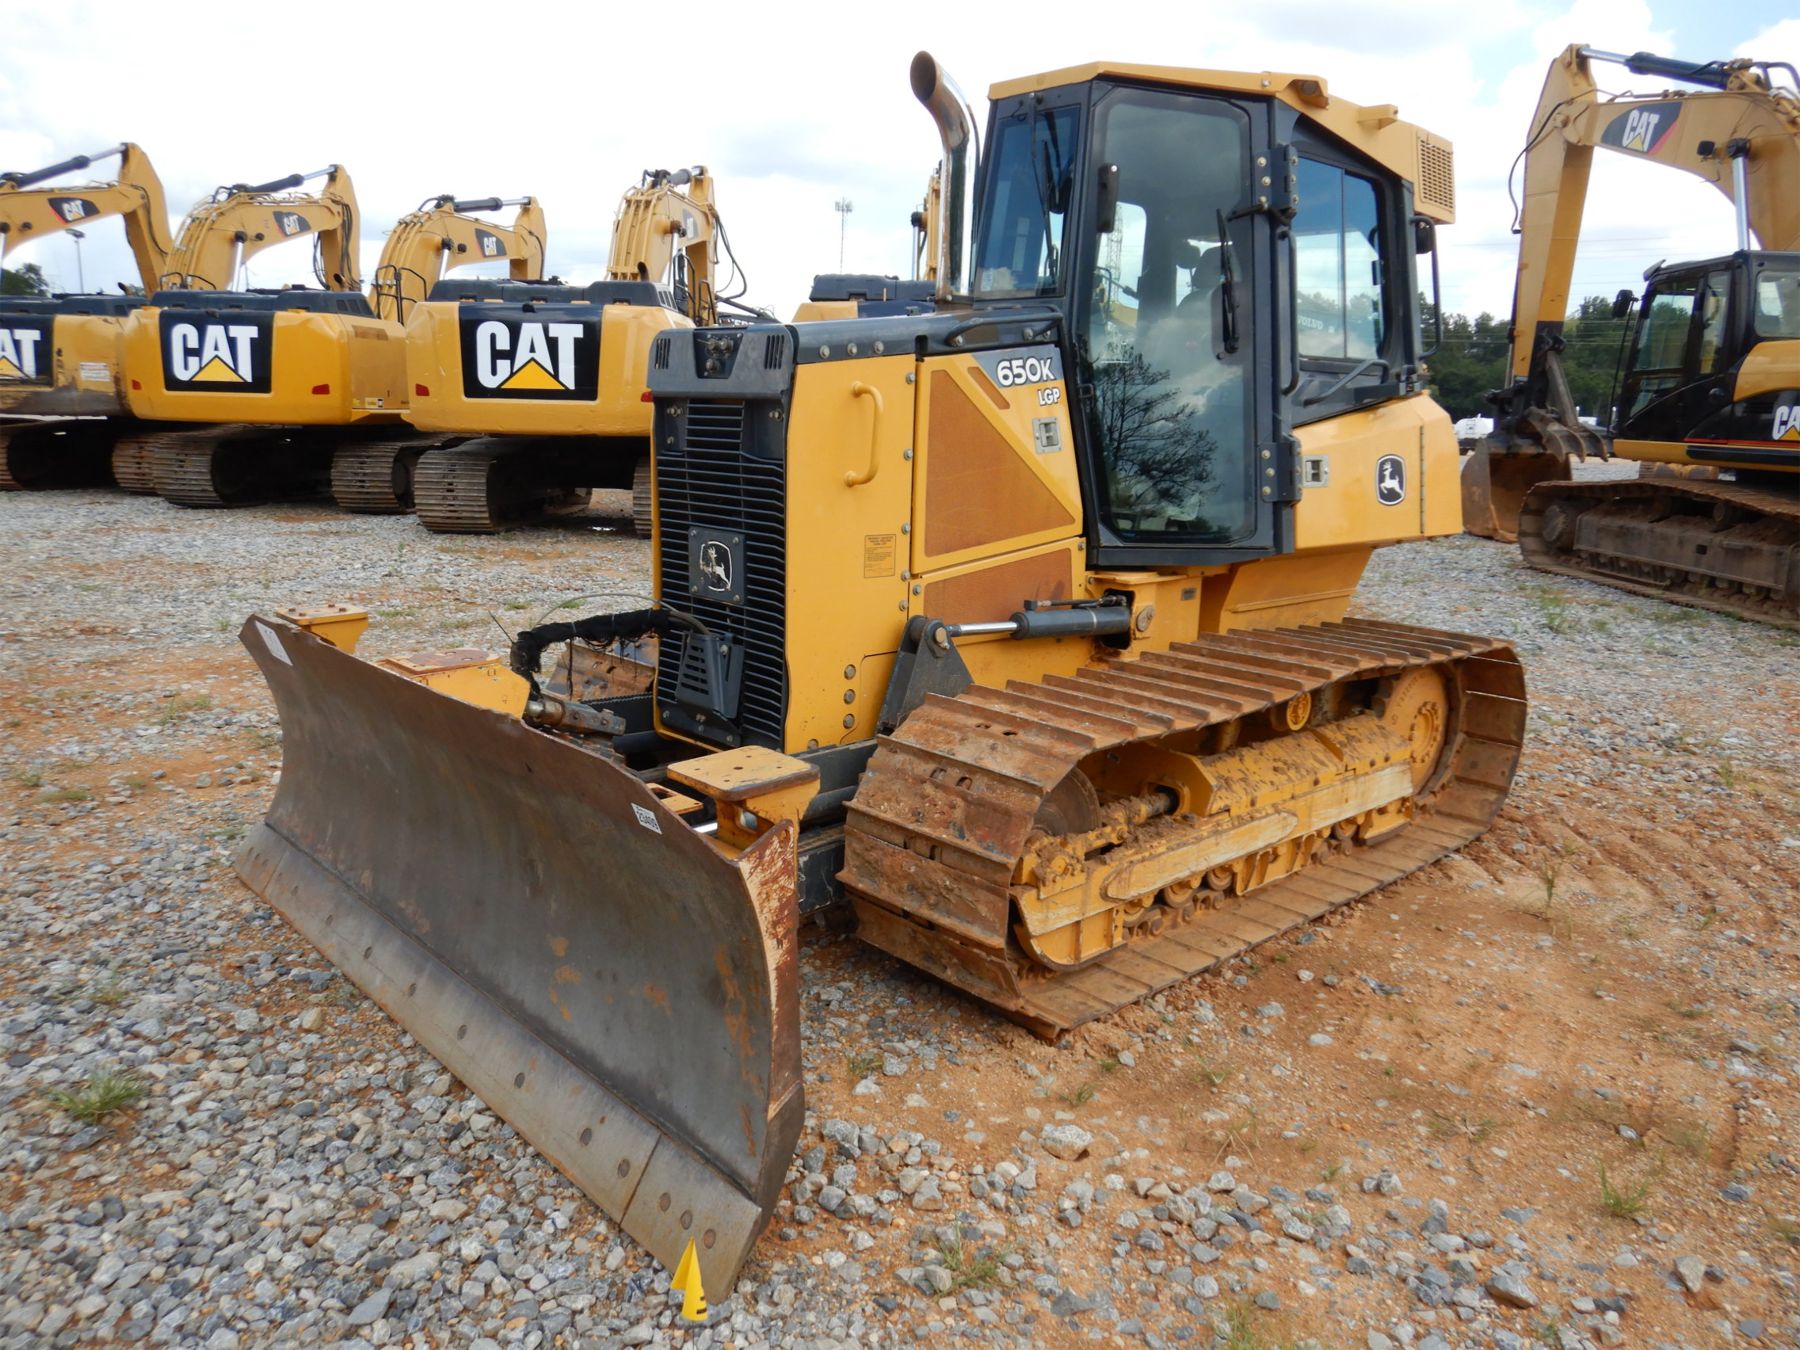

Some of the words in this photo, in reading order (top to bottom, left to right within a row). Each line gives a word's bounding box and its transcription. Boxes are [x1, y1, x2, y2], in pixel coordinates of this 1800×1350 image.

[1621, 109, 1660, 152] CAT
[62, 200, 86, 221] CAT
[283, 215, 300, 235] CAT
[483, 236, 497, 256] CAT
[0, 329, 41, 379] AT
[171, 323, 259, 383] CAT
[476, 320, 584, 391] CAT
[996, 357, 1055, 387] 650K
[1038, 387, 1061, 406] LGP
[1772, 405, 1800, 440] CA
